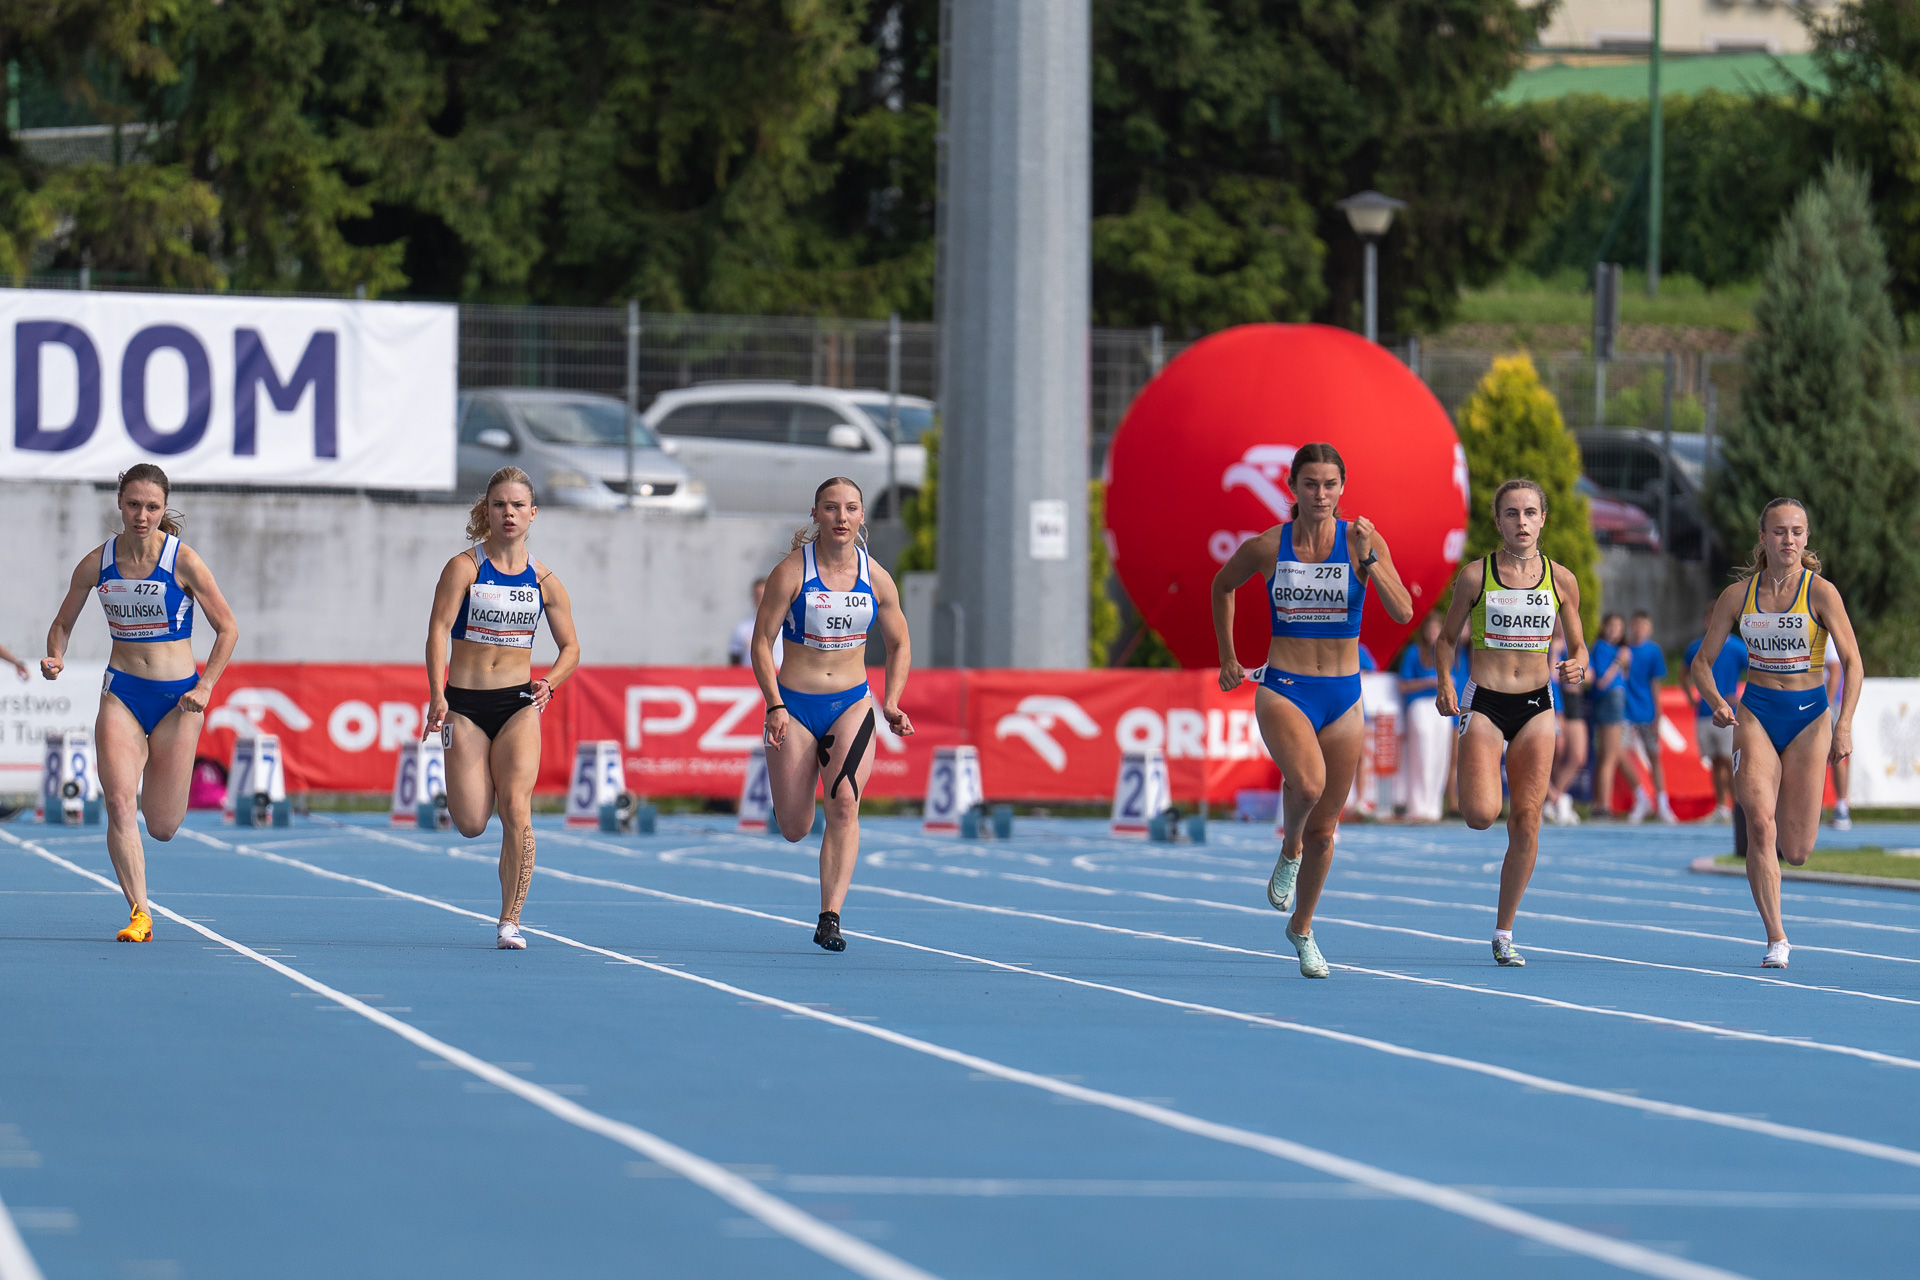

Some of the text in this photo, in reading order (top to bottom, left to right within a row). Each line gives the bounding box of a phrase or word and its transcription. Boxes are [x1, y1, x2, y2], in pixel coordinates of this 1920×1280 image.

[14, 319, 338, 459] DOM
[1314, 567, 1342, 579] 278
[134, 583, 159, 595] 472
[509, 590, 534, 602] 588
[1275, 585, 1345, 603] BROŻYNA
[844, 595, 867, 608] 104
[1526, 593, 1550, 606] 561
[104, 602, 164, 618] CYRULIŃSKA
[471, 608, 537, 625] KACZMAREK
[826, 614, 852, 630] SEŃ
[1491, 614, 1551, 628] OBAREK
[1777, 617, 1803, 629] 553
[1745, 635, 1807, 651] KALIŃSKA
[1460, 713, 1469, 735] 5
[444, 725, 450, 747] 8
[45, 752, 61, 797] 8
[72, 752, 89, 800] 8
[262, 755, 276, 793] 7
[400, 758, 417, 806] 6
[426, 758, 442, 802] 6
[576, 757, 596, 809] 5
[933, 766, 956, 814] 3
[1121, 766, 1145, 818] 2
